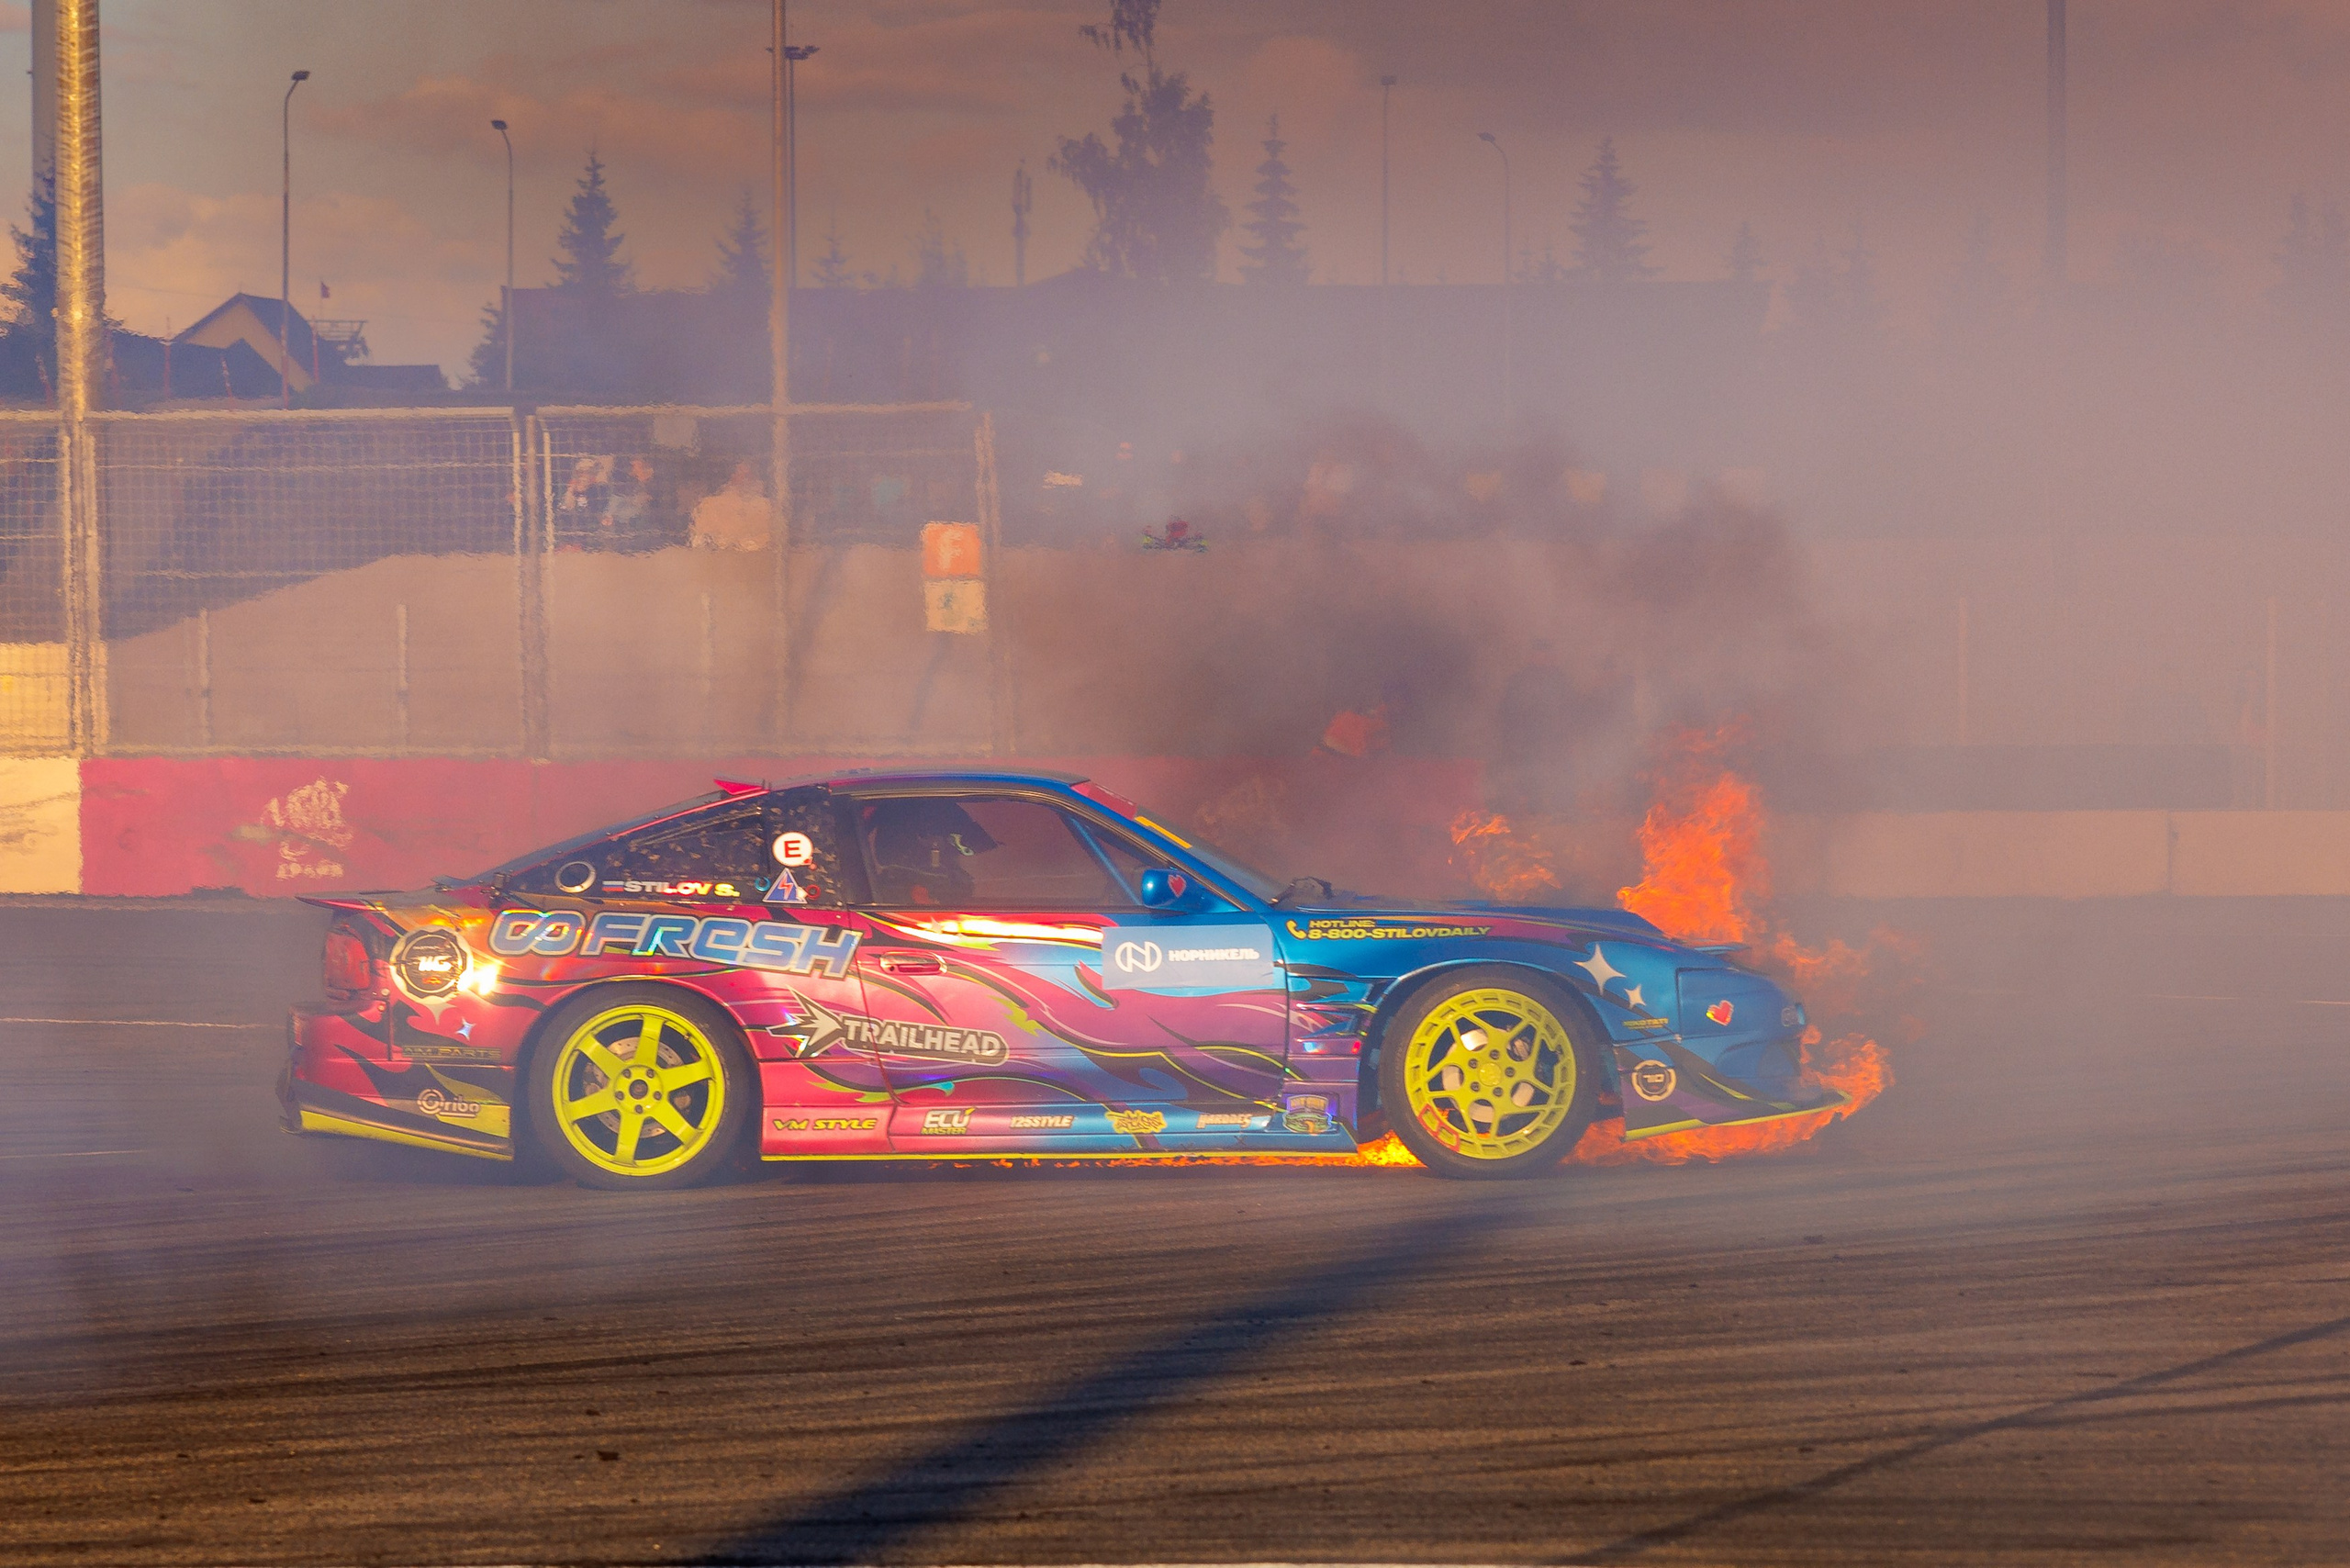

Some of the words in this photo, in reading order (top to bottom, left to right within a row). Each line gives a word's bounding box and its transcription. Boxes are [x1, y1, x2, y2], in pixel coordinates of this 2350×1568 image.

[784, 839, 802, 858] E
[623, 879, 713, 896] STILOV
[1307, 926, 1492, 939] 8-800-STILOVDAILY
[1168, 948, 1260, 962] НОРНИКЕЛЬ
[844, 1019, 1002, 1057] TRAILHEAD
[772, 1119, 810, 1130] VM
[812, 1118, 878, 1129] STYLE
